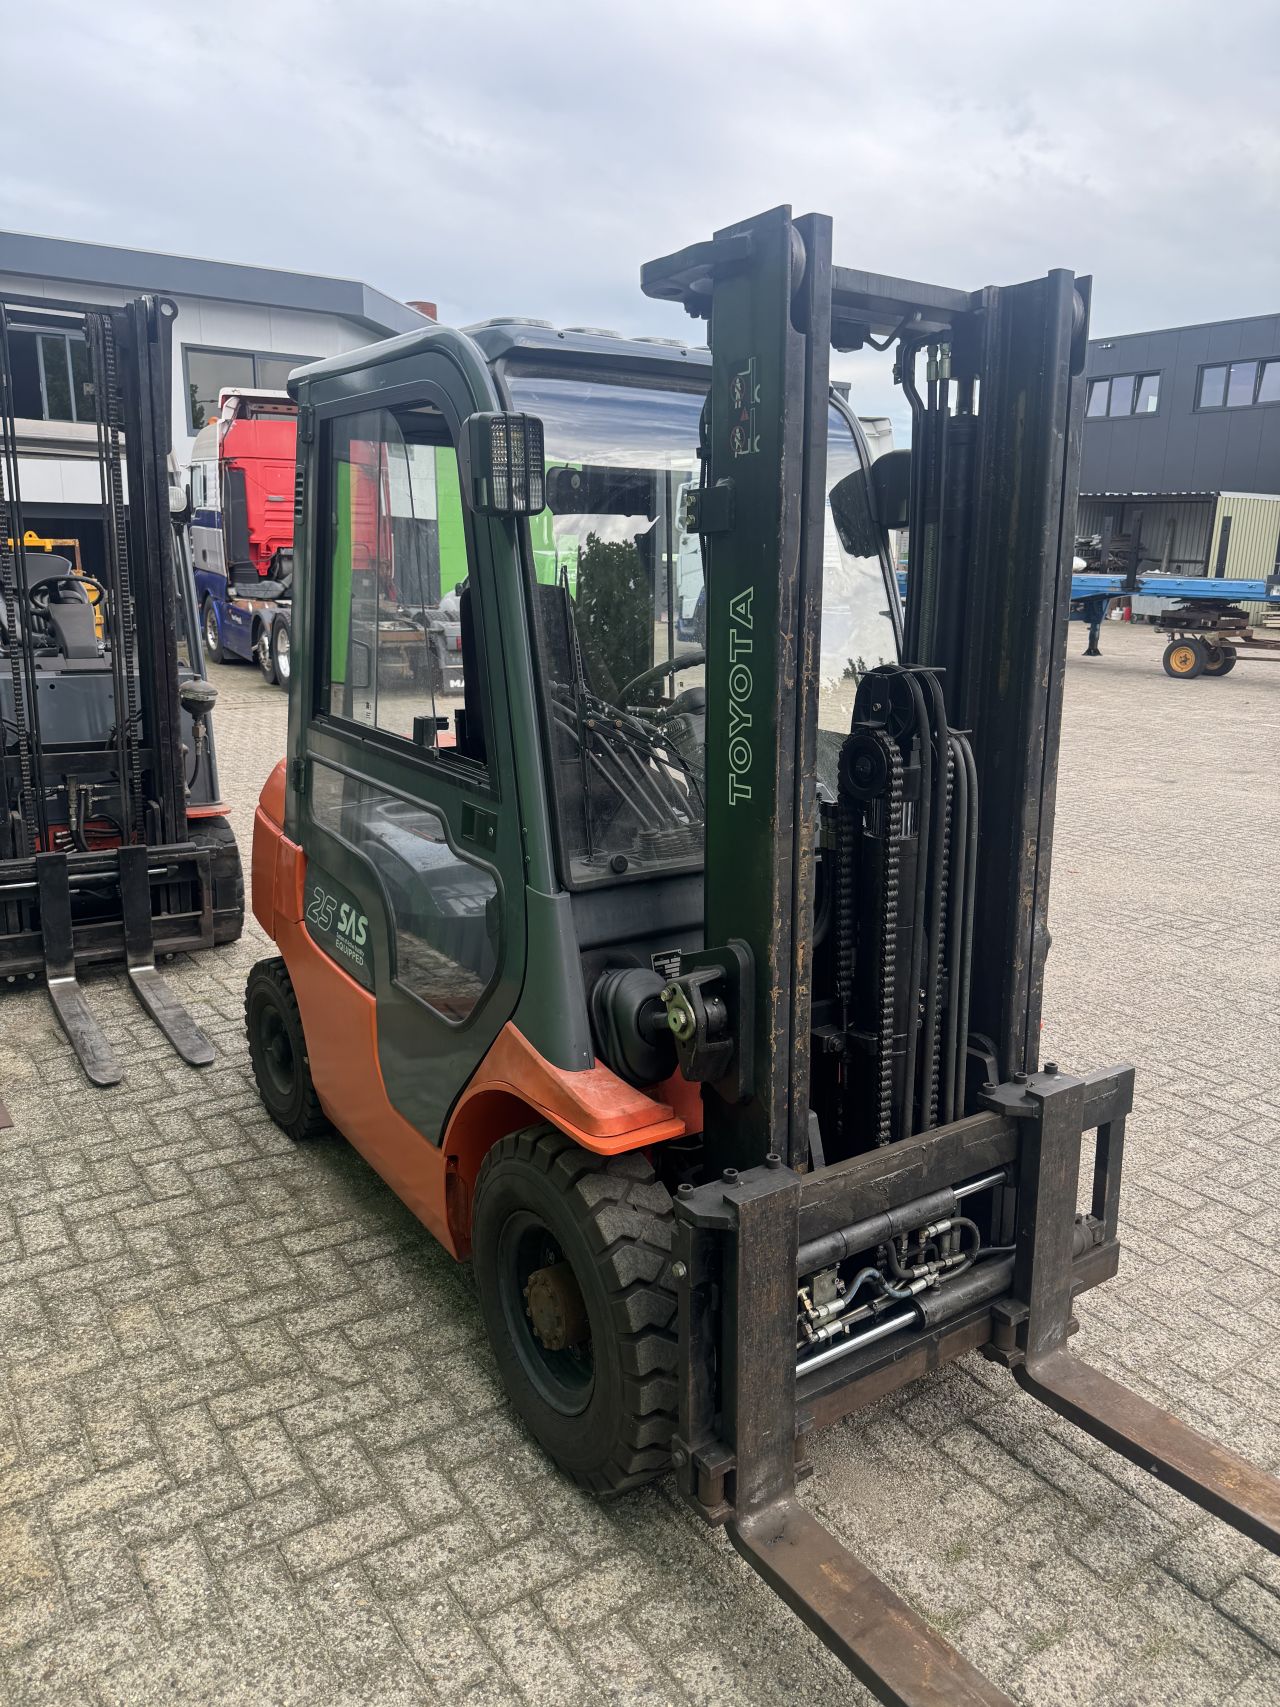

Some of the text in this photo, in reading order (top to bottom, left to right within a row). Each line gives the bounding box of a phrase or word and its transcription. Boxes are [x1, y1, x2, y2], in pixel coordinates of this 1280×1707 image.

[729, 586, 753, 805] TOYOTA
[306, 886, 338, 931] 25
[337, 902, 369, 946] SAS
[335, 938, 364, 966] EQUIPPED
